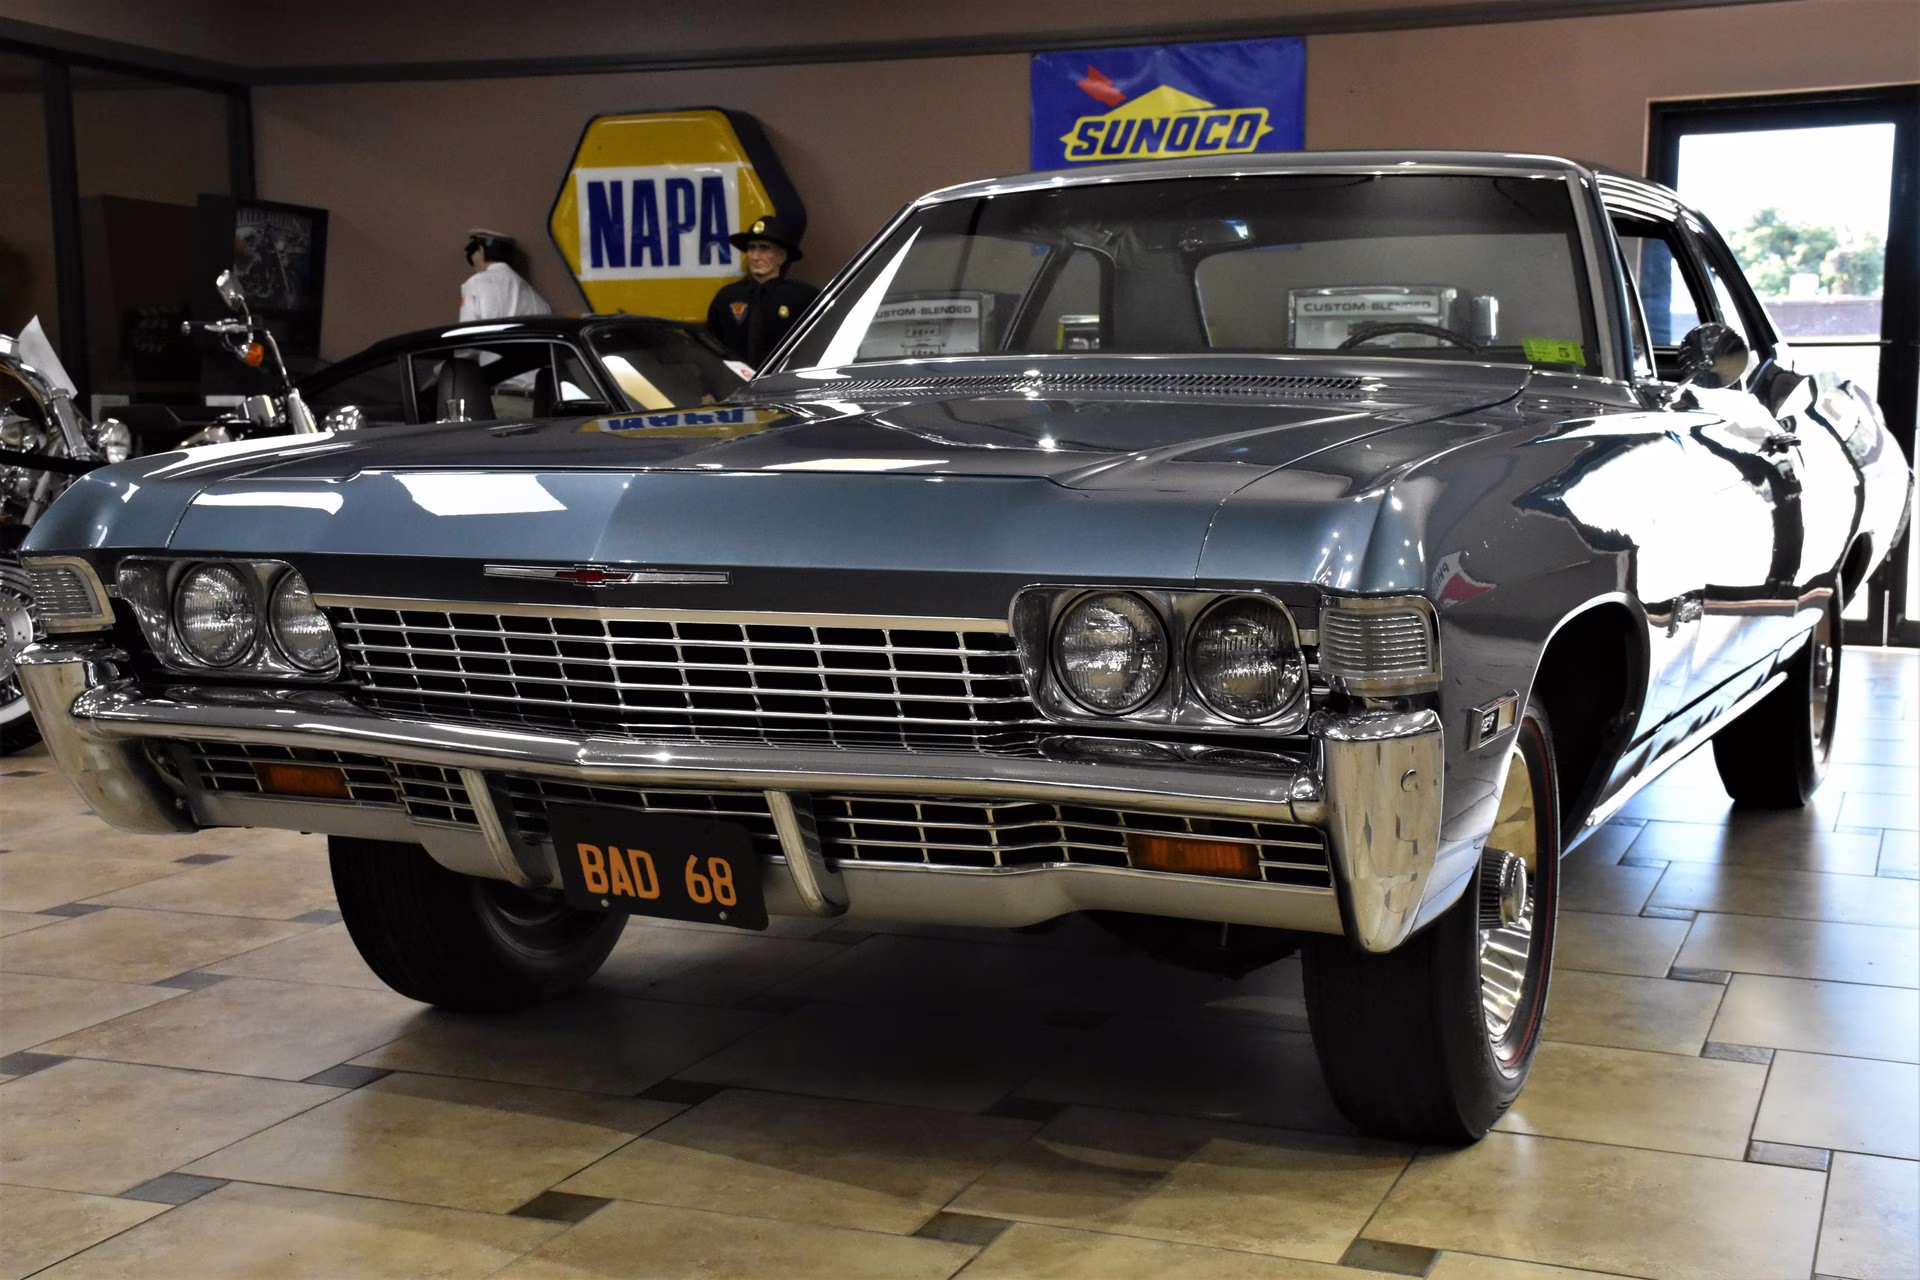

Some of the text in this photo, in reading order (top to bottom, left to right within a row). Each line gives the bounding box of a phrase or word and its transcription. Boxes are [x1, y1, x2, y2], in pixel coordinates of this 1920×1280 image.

[1070, 112, 1263, 156] SUNOCO
[587, 176, 732, 268] NAPA
[576, 842, 738, 907] BAD 68
